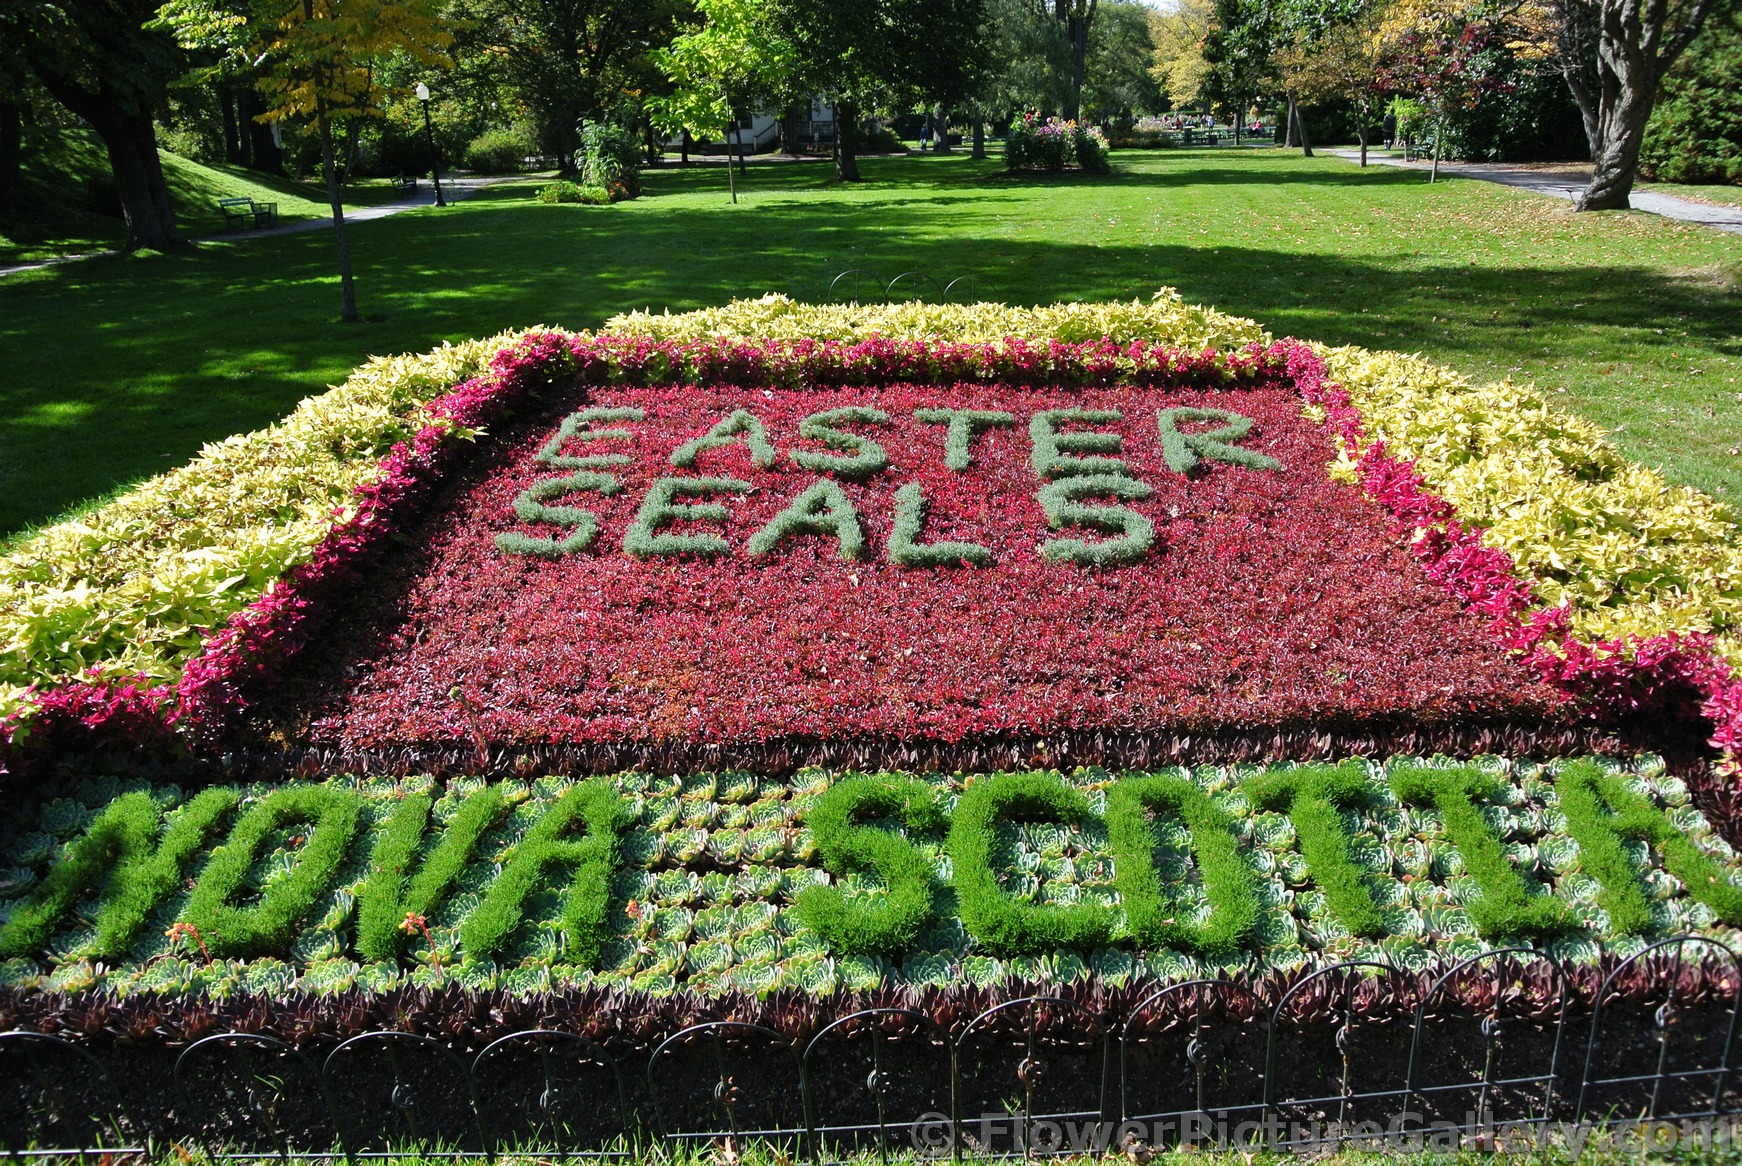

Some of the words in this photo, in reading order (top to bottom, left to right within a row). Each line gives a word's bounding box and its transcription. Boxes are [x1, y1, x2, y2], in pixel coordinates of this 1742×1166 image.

[534, 405, 1281, 475] EASTER
[495, 472, 1155, 567] SEALS
[0, 784, 630, 966] NOVA
[798, 757, 1742, 955] SCOTIA
